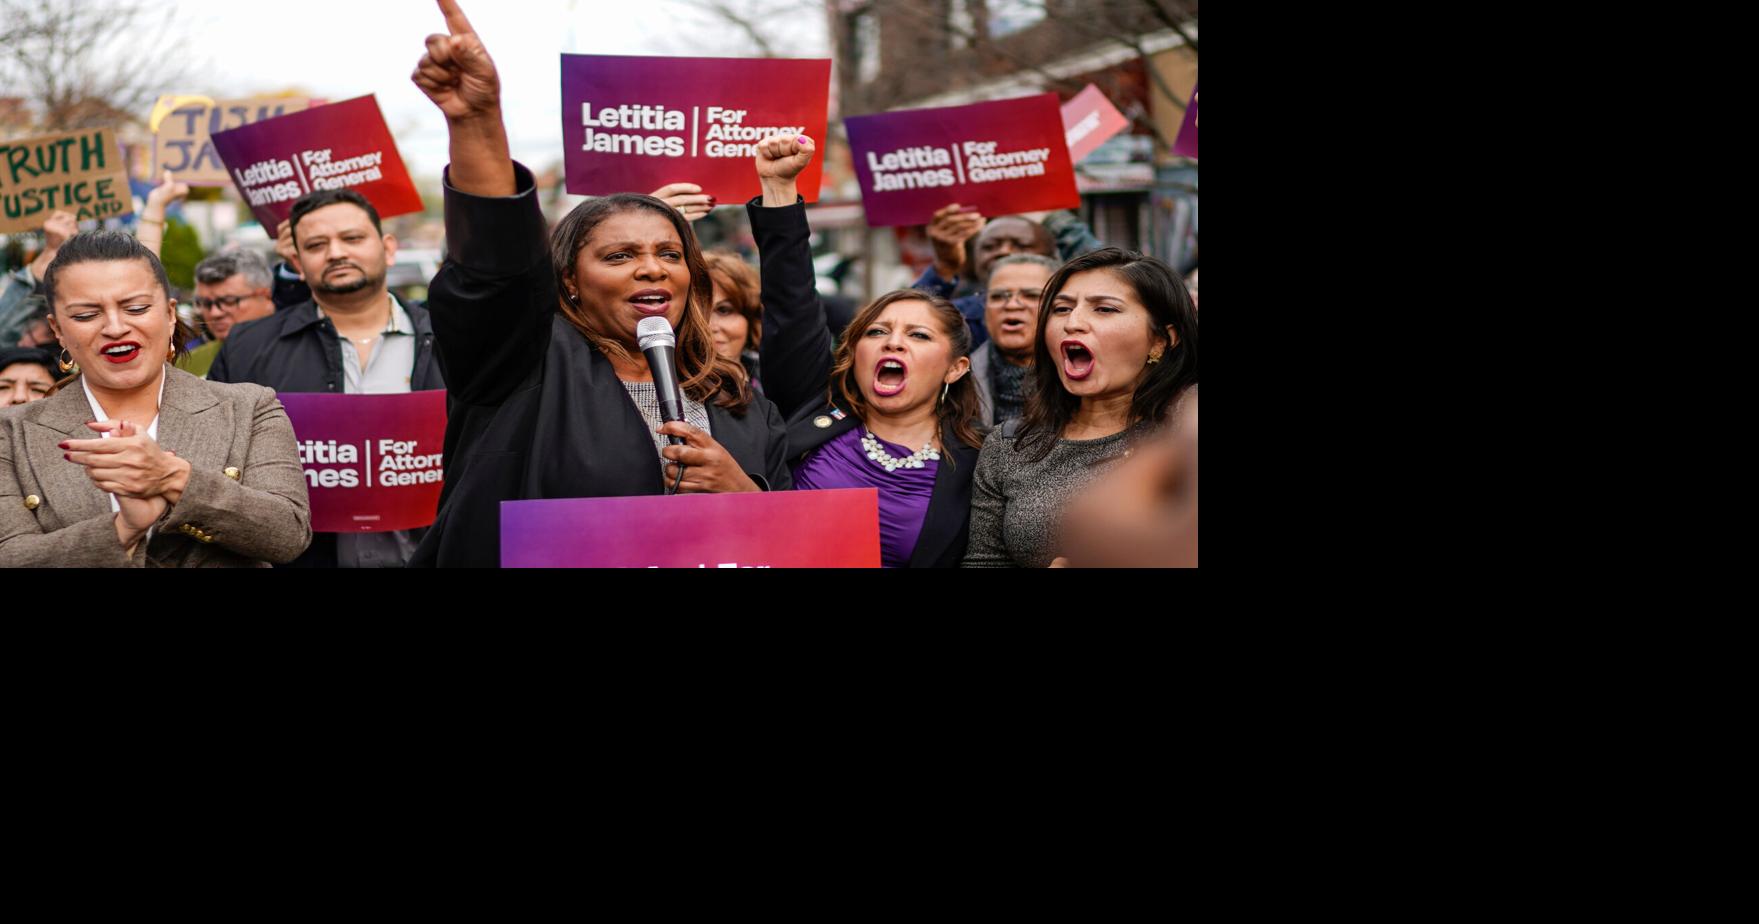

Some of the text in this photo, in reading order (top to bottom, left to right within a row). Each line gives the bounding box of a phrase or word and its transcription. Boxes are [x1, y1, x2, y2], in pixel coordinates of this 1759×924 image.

[582, 102, 686, 131] Letitia
[706, 106, 747, 125] For
[582, 128, 685, 157] James
[963, 141, 998, 156] For
[301, 148, 333, 166] For
[309, 151, 383, 181] Attorney
[866, 145, 951, 172] Letitia
[967, 148, 1051, 170] Attorney
[234, 158, 294, 188] Letitia
[313, 166, 383, 192] General
[872, 167, 956, 192] James
[968, 162, 1046, 183] General
[0, 178, 115, 219] USTICE
[76, 201, 123, 222] AND
[379, 440, 418, 456] For
[379, 469, 443, 487] Gener
